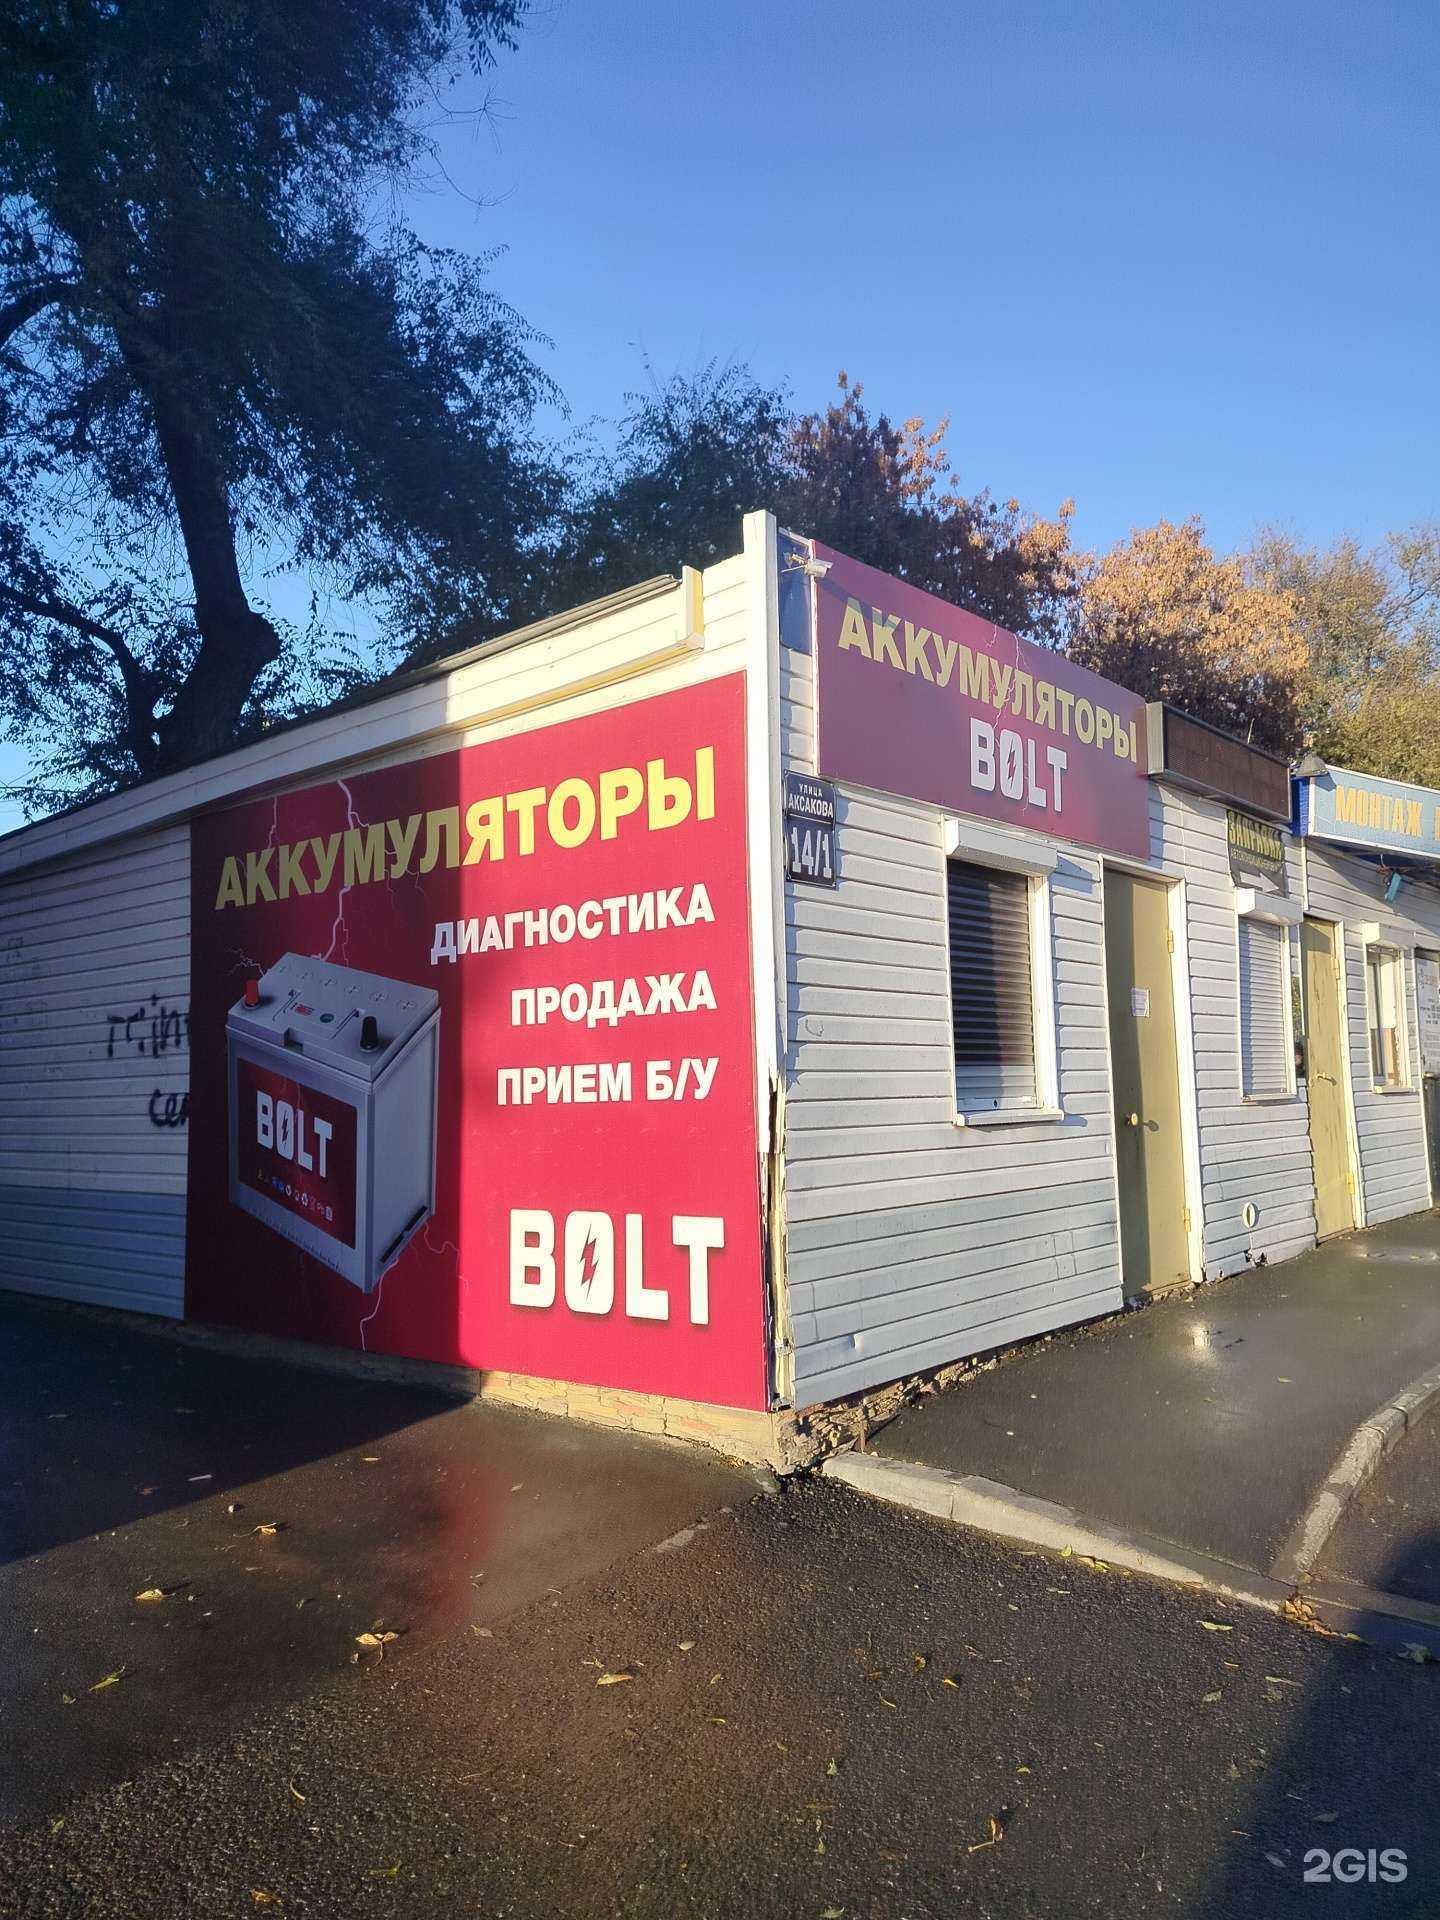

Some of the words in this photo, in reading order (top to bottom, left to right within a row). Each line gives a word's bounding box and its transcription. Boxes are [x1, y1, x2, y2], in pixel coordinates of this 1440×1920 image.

[838, 597, 1137, 763] АККУМУЛЯТОРЫ
[799, 784, 822, 797] УЛИЦА
[970, 717, 1068, 813] BOLT
[214, 745, 715, 910] АККУМУЛЯТОРЫ
[788, 793, 834, 818] АКСАКОВА
[1335, 785, 1423, 837] МОНТАЖ
[791, 827, 832, 878] 14/1
[430, 883, 715, 965] ДИАГНОСТИКА
[511, 970, 718, 1028] ПРОДАЖА
[497, 1062, 632, 1105] ПРИЕМ
[646, 1057, 720, 1101] Б/У
[257, 1090, 333, 1178] BOLT
[509, 1209, 725, 1325] BOLT
